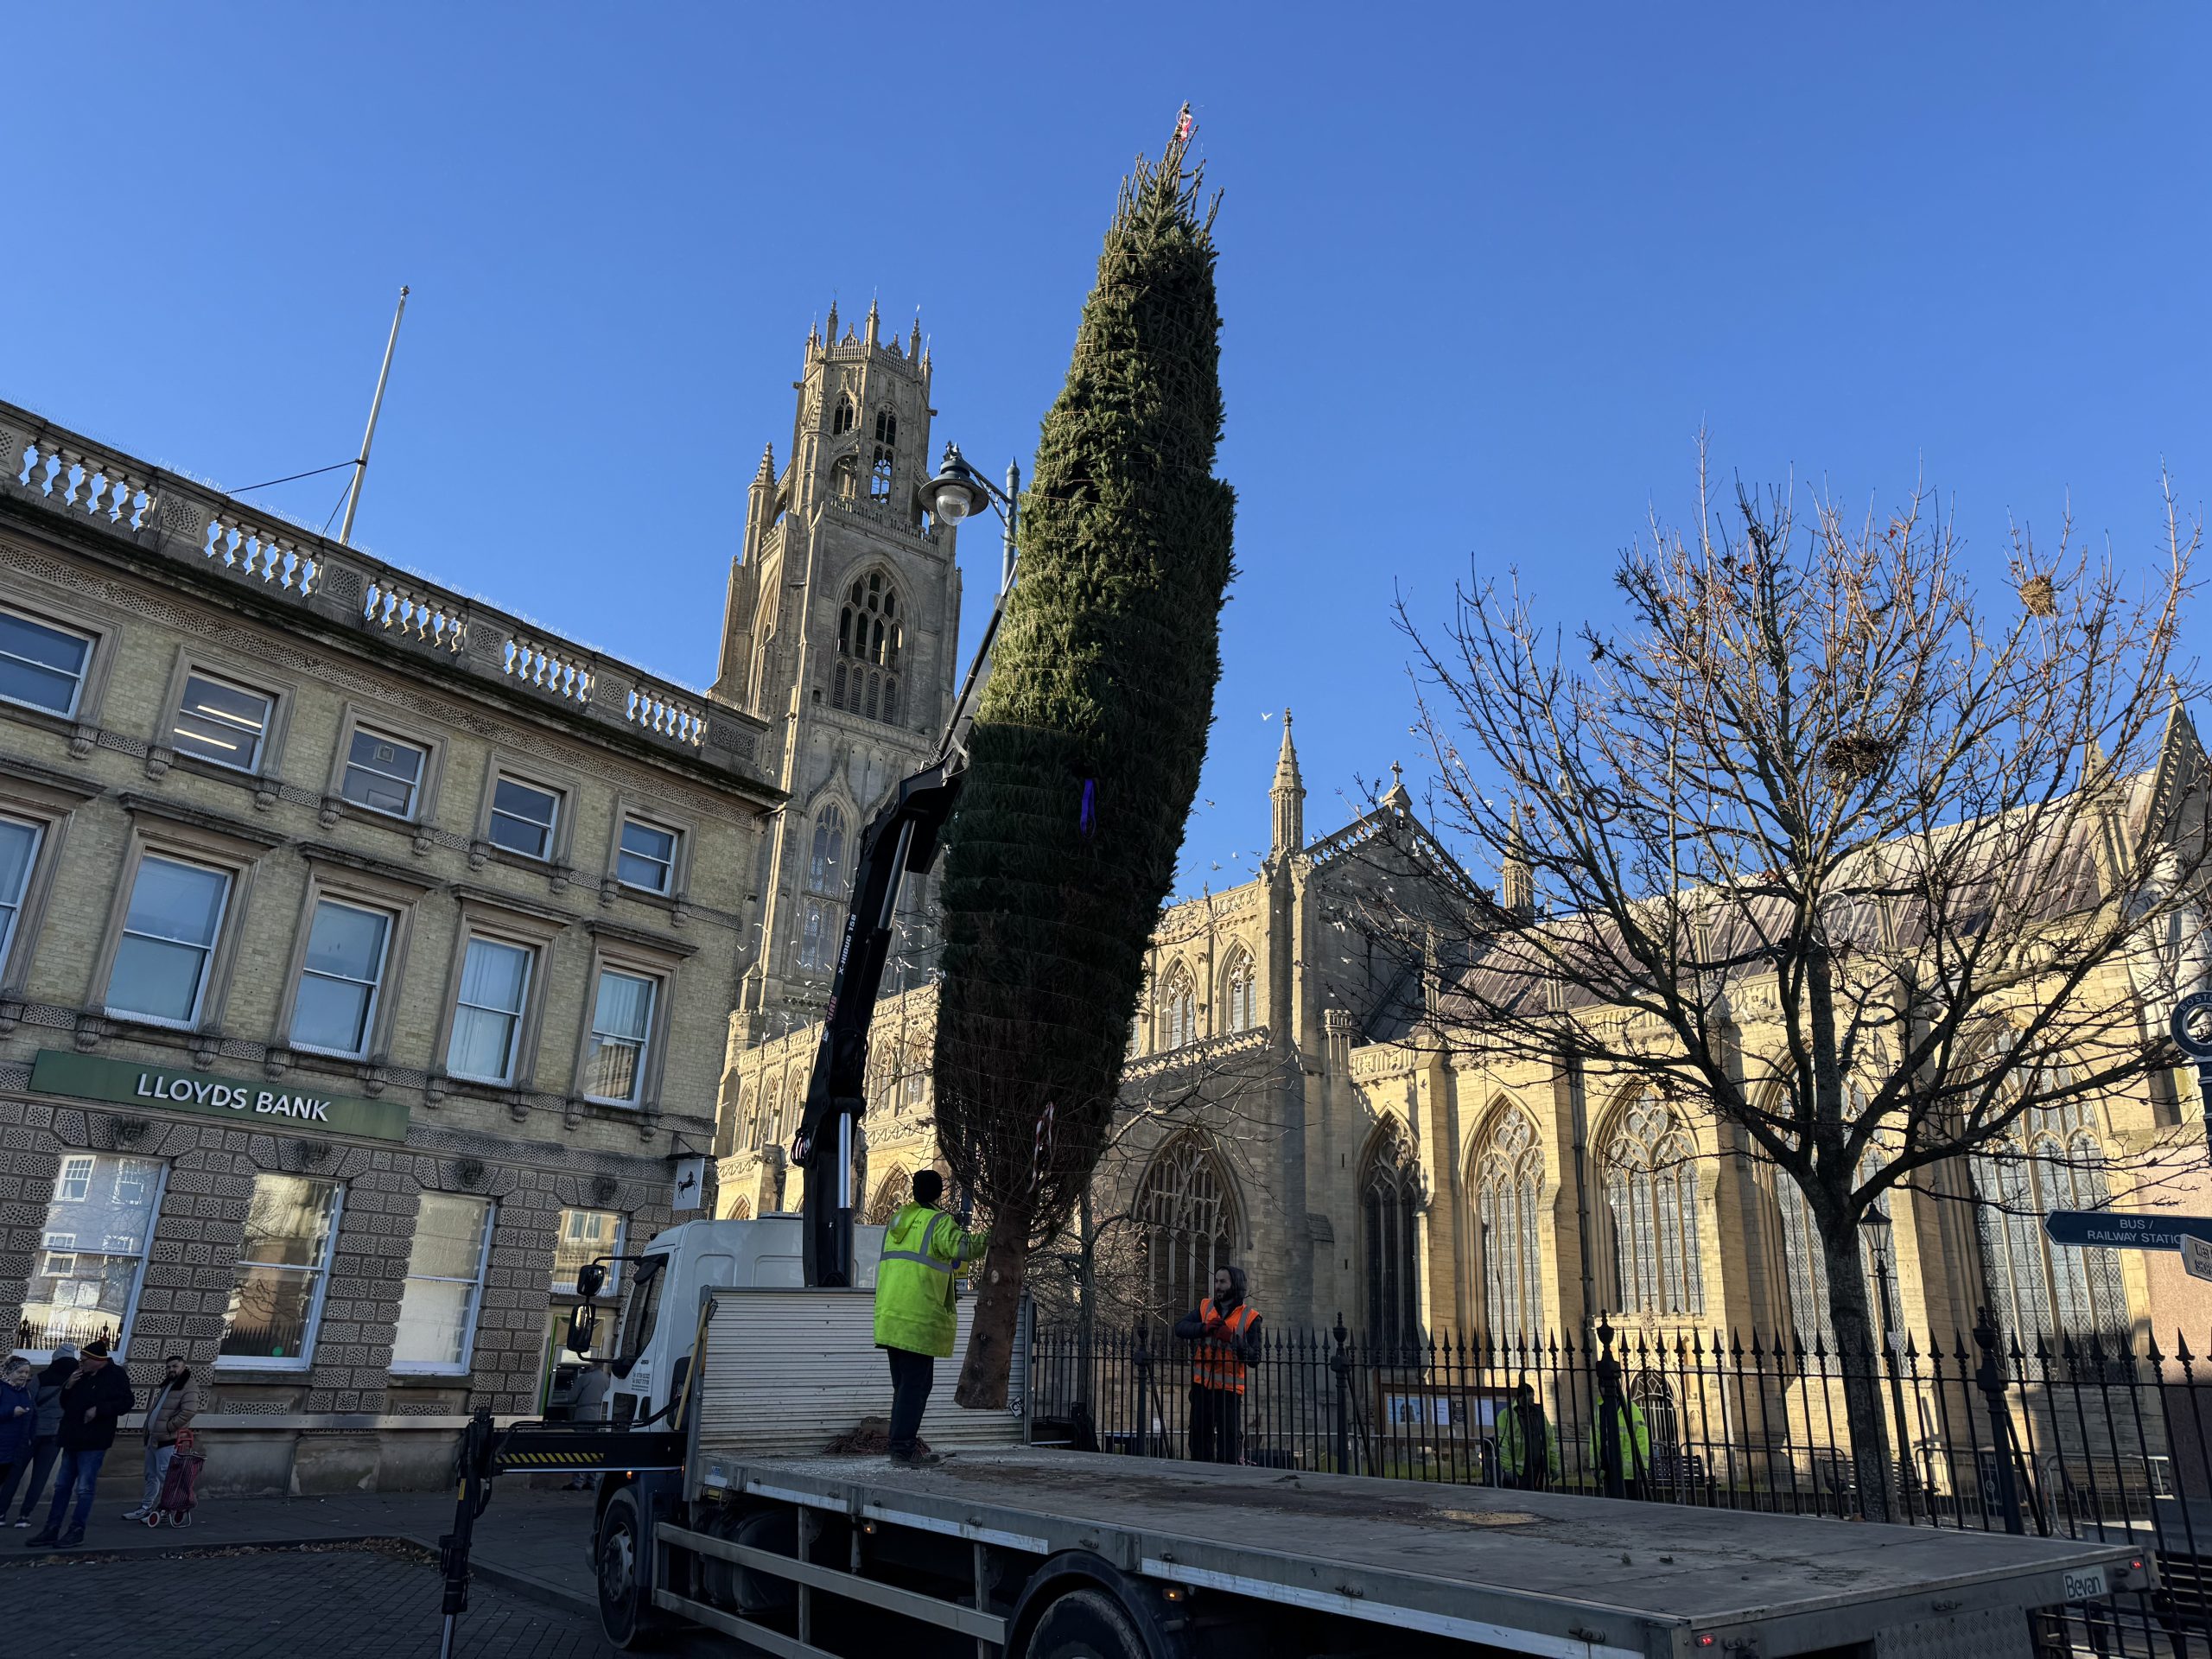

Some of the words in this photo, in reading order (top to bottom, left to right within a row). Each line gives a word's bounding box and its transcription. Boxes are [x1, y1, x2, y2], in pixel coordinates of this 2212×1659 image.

[2180, 994, 2212, 1011] BOST
[137, 1073, 248, 1109] LLOYDS
[255, 1091, 331, 1122] BANK
[2120, 1218, 2145, 1230] BUS
[2149, 1219, 2154, 1230] /
[2087, 1230, 2138, 1243] RAILWAY
[2064, 1574, 2102, 1599] Bevan
